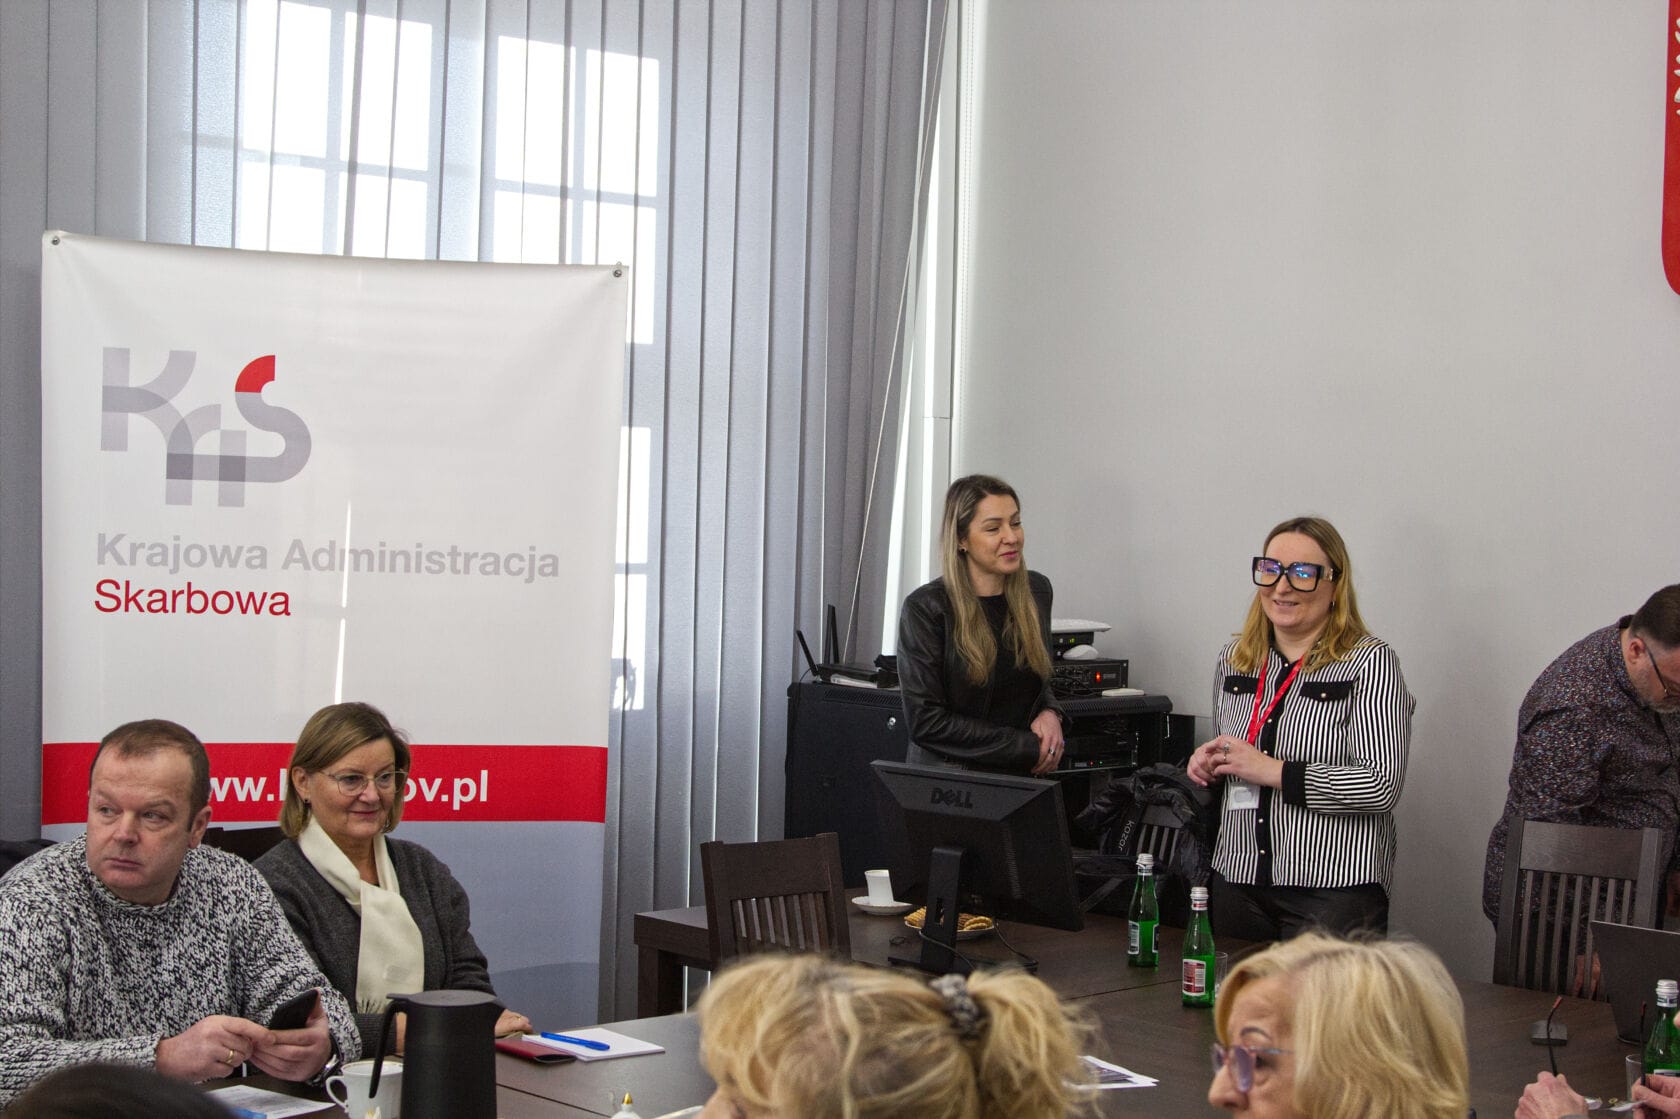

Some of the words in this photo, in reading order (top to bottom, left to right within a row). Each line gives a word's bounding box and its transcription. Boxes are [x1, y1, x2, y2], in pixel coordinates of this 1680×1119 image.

[96, 533, 268, 575] Krajowa
[281, 539, 560, 584] Administracja
[94, 579, 291, 616] Skarbowa
[931, 788, 973, 809] DELL
